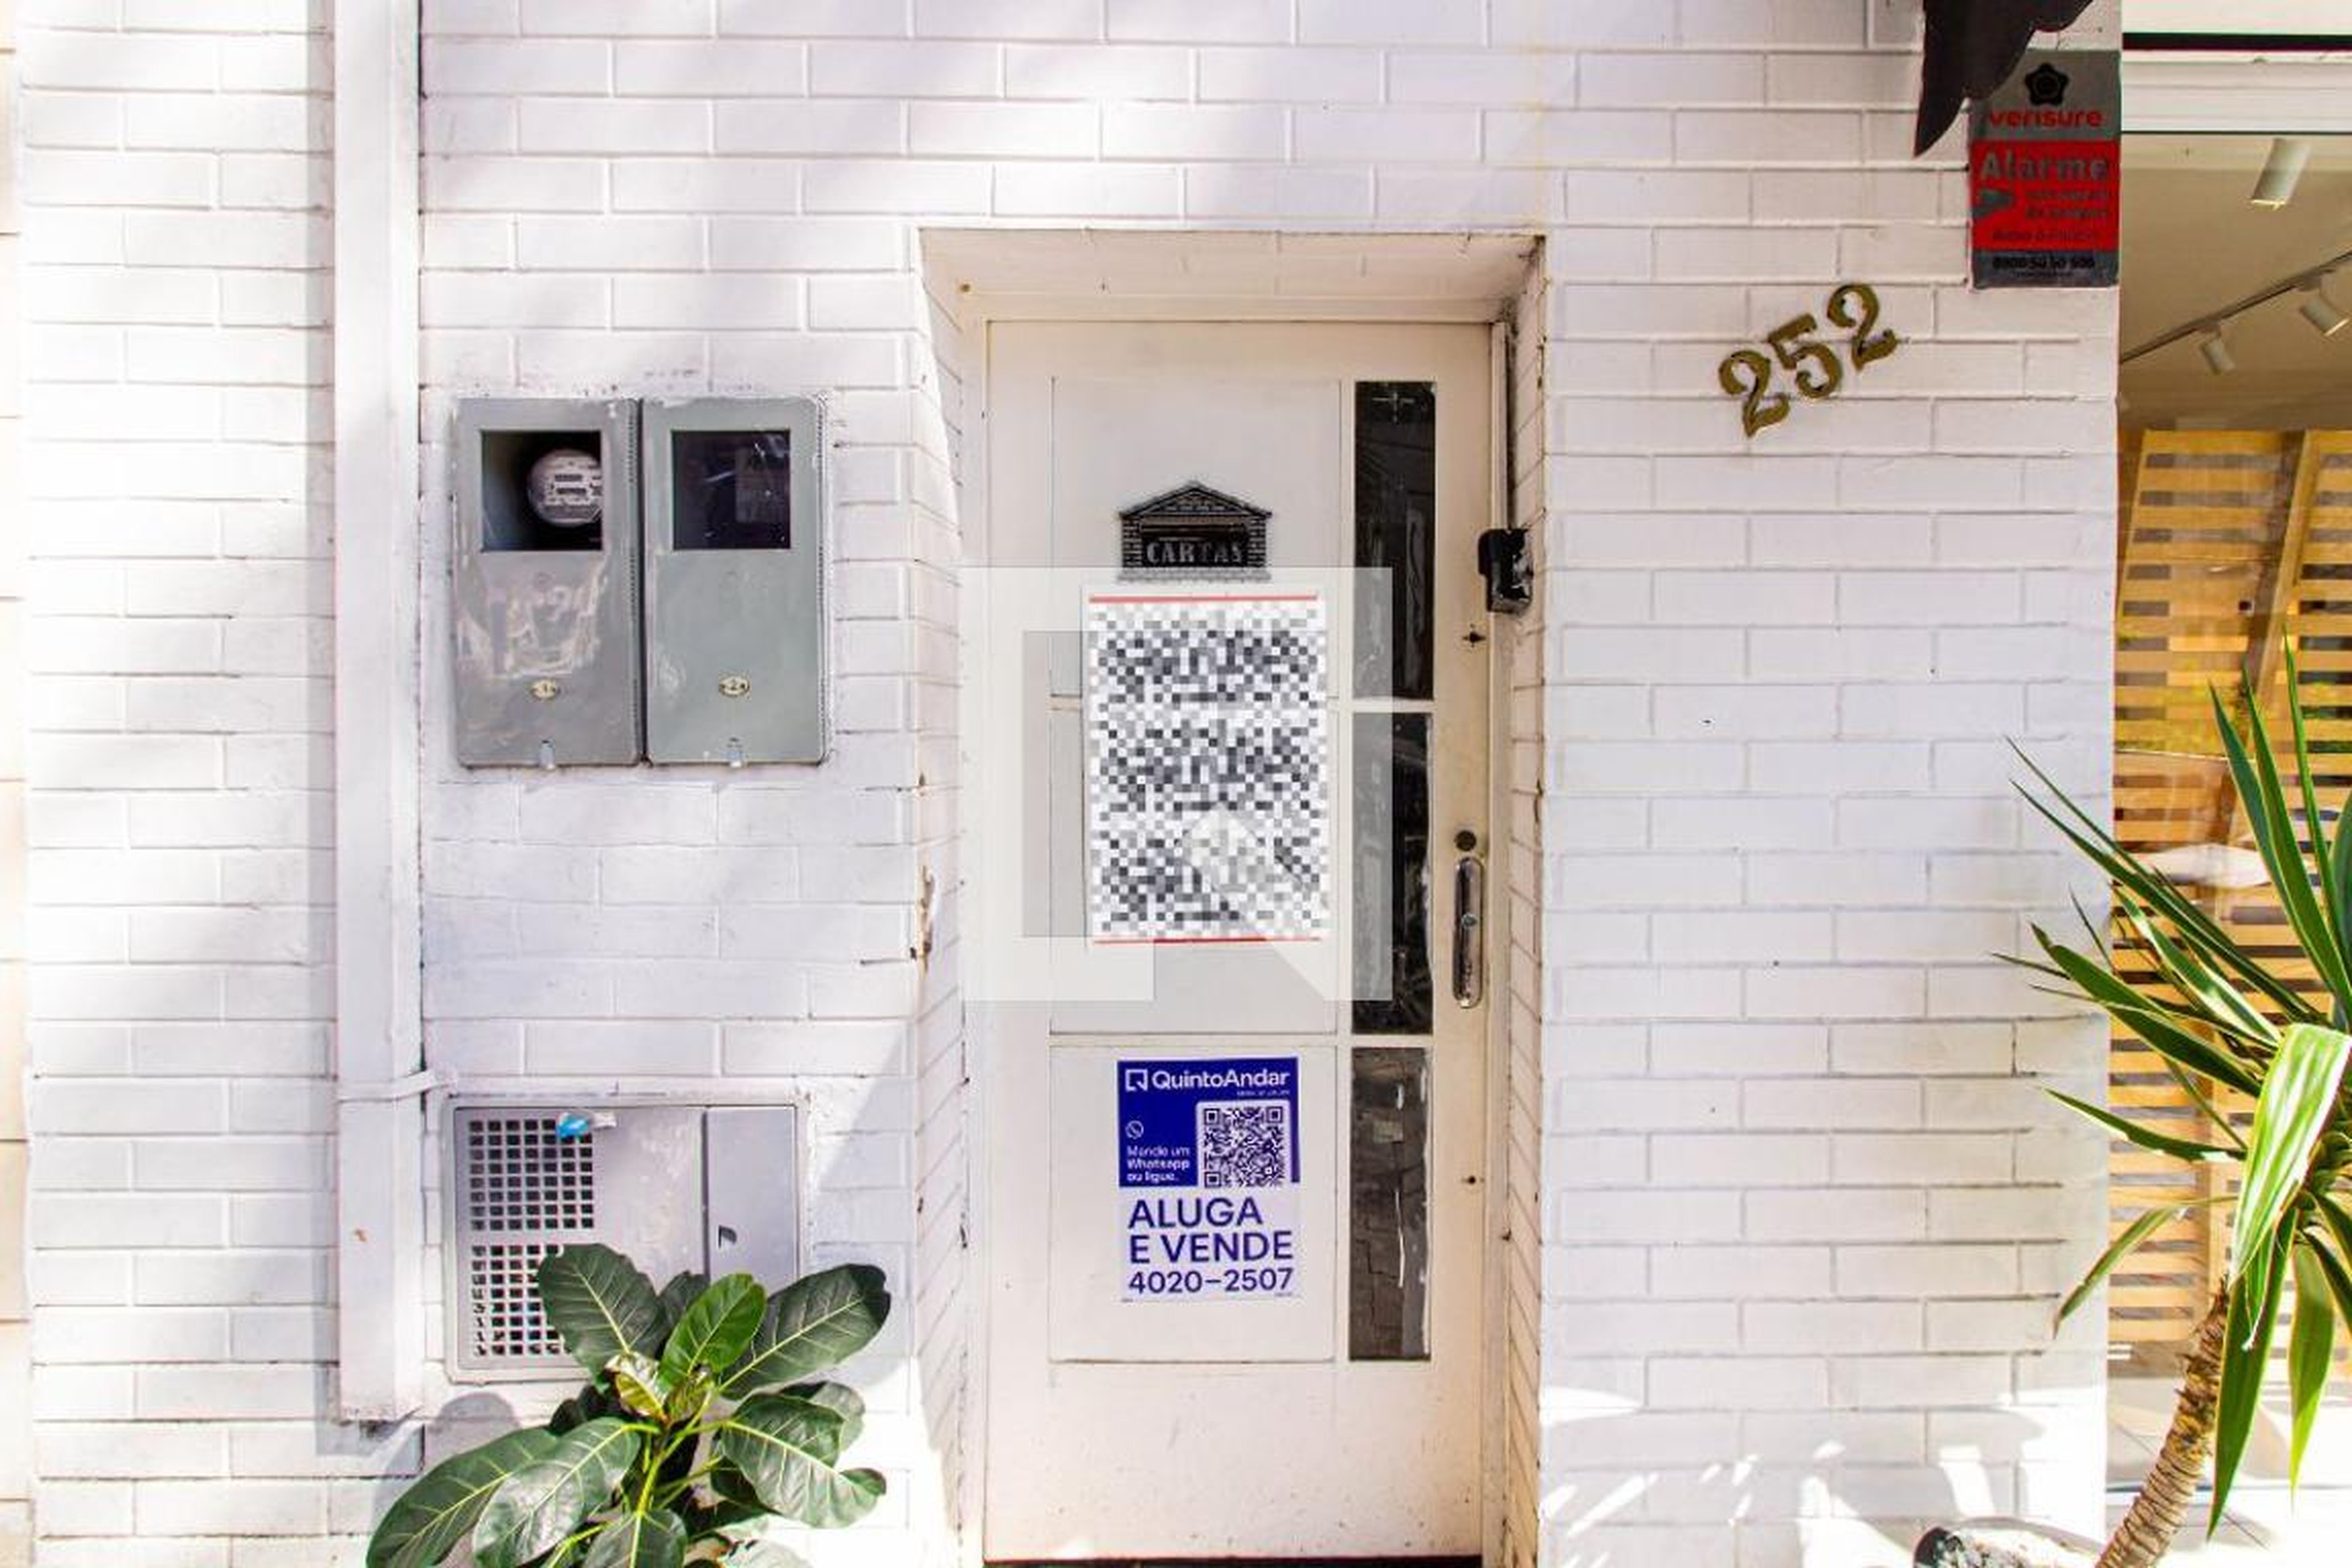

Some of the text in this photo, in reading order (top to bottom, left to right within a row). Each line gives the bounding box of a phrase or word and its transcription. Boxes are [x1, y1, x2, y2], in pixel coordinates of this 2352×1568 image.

[1991, 110, 2102, 128] verisure
[1980, 149, 2108, 180] Alarme
[1719, 283, 1898, 437] 252
[1147, 542, 1242, 563] CARTAS
[1152, 1069, 1290, 1089] QuintoAndar
[1171, 1147, 1190, 1156] um
[1127, 1173, 1143, 1182] ou
[1128, 1197, 1263, 1229] ALUGA
[1130, 1231, 1293, 1264] E VENDE
[1129, 1268, 1293, 1294] 4020-2507
